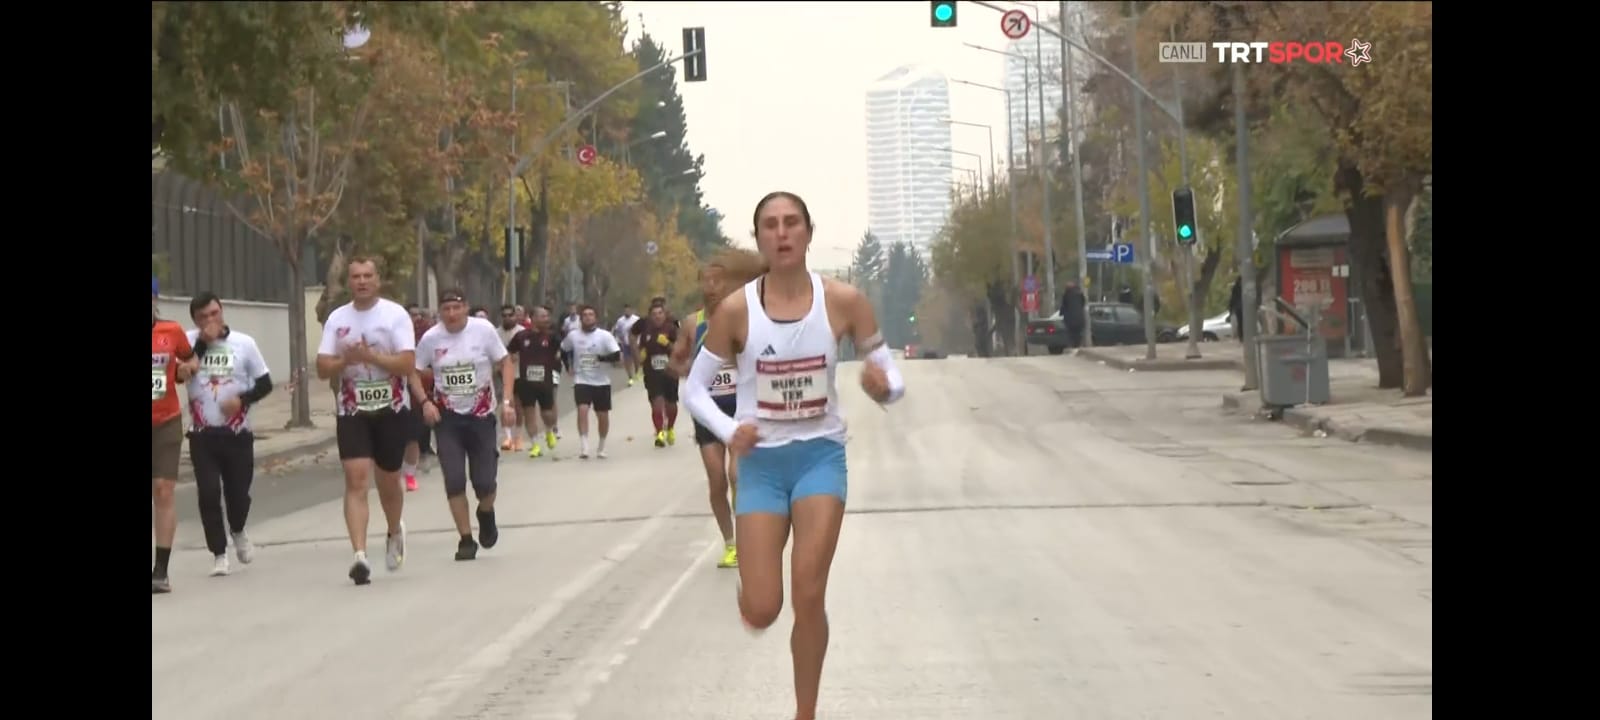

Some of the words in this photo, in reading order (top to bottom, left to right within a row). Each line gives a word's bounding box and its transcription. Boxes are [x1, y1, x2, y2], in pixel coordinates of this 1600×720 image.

[1117, 244, 1130, 263] P
[204, 355, 229, 366] 1149
[446, 373, 474, 386] 1083
[359, 388, 390, 402] 1602
